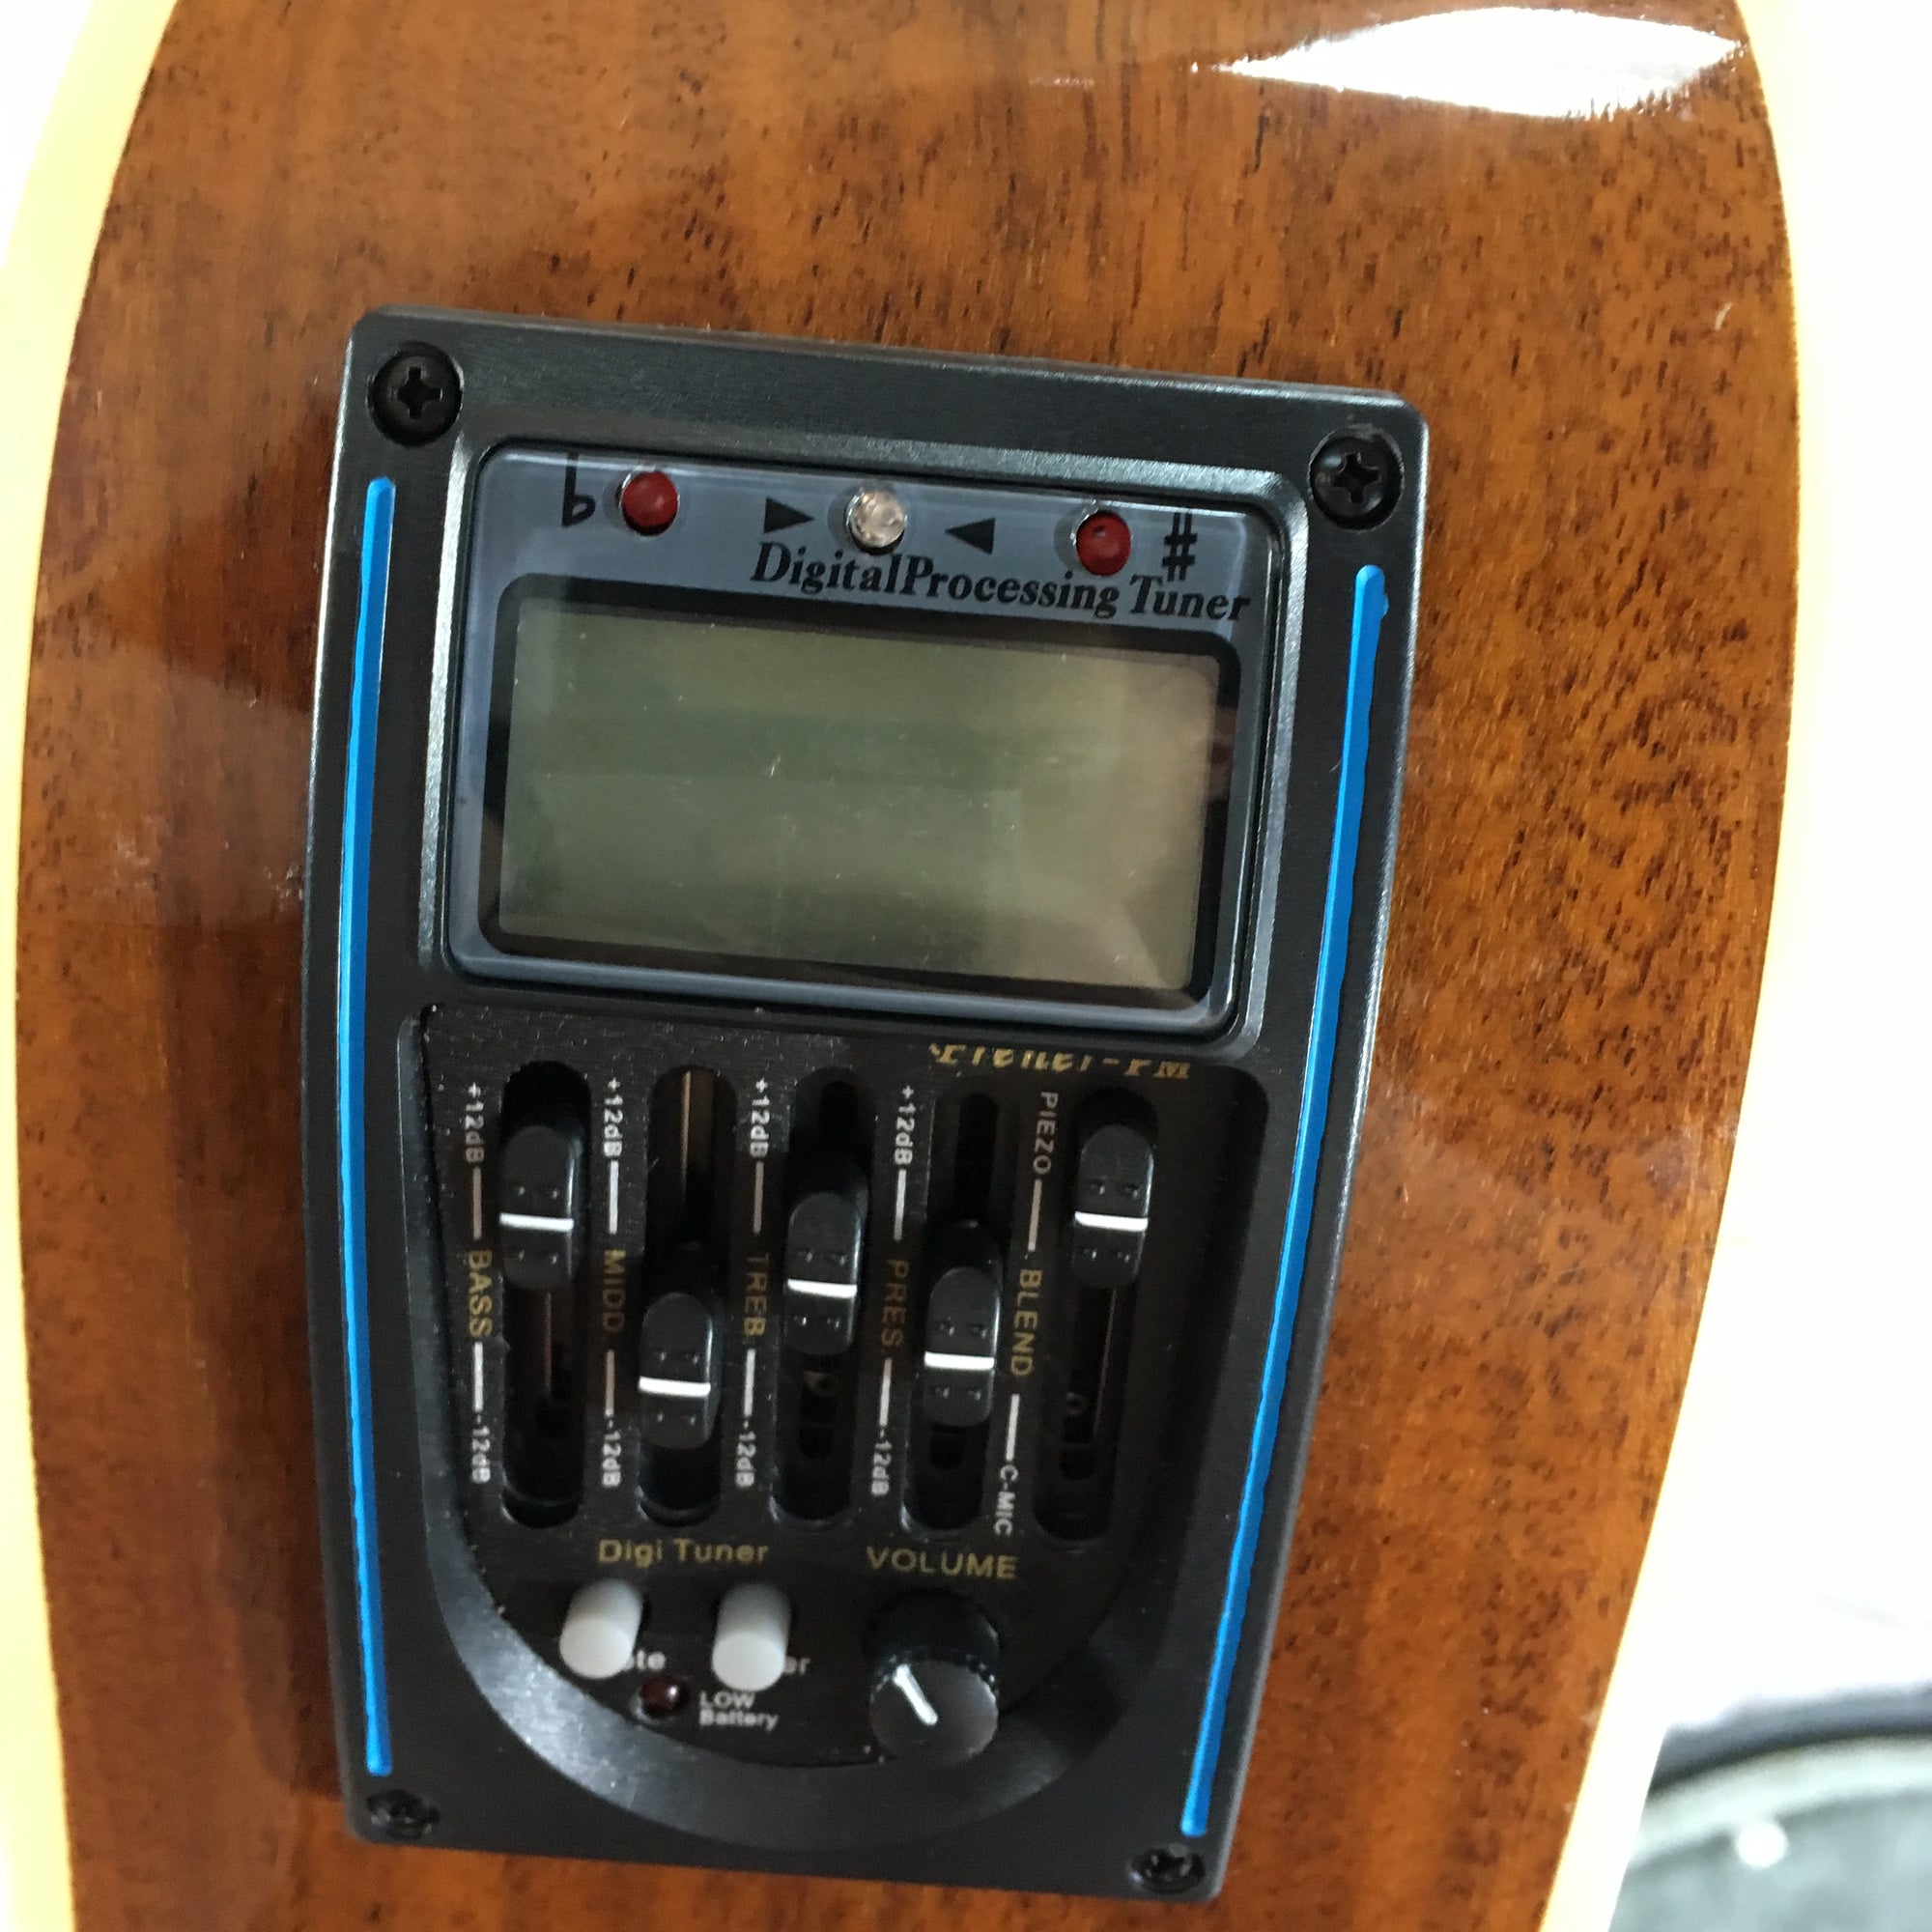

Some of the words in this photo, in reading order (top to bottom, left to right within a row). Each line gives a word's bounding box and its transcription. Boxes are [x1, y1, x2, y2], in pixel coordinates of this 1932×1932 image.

[1128, 574, 1252, 621] Tuner
[465, 1082, 486, 1164] +12dB
[603, 1078, 624, 1158] +12dB
[750, 1078, 772, 1158] +12dB
[894, 1085, 916, 1166] +12dB
[1033, 1092, 1059, 1176] PIEZO
[469, 1250, 492, 1338] BASS
[1010, 1267, 1042, 1377] BLEND
[471, 1415, 491, 1485] -12dB
[602, 1419, 622, 1490] -12dB
[735, 1420, 756, 1490] -12dB
[871, 1428, 894, 1497] -12dB
[993, 1464, 1019, 1537] C-MIC
[597, 1540, 664, 1569] Digi
[675, 1539, 769, 1564] Tuner
[867, 1546, 1018, 1581] VOLUME
[698, 1690, 755, 1710] LOW
[698, 1707, 780, 1733] Battery
